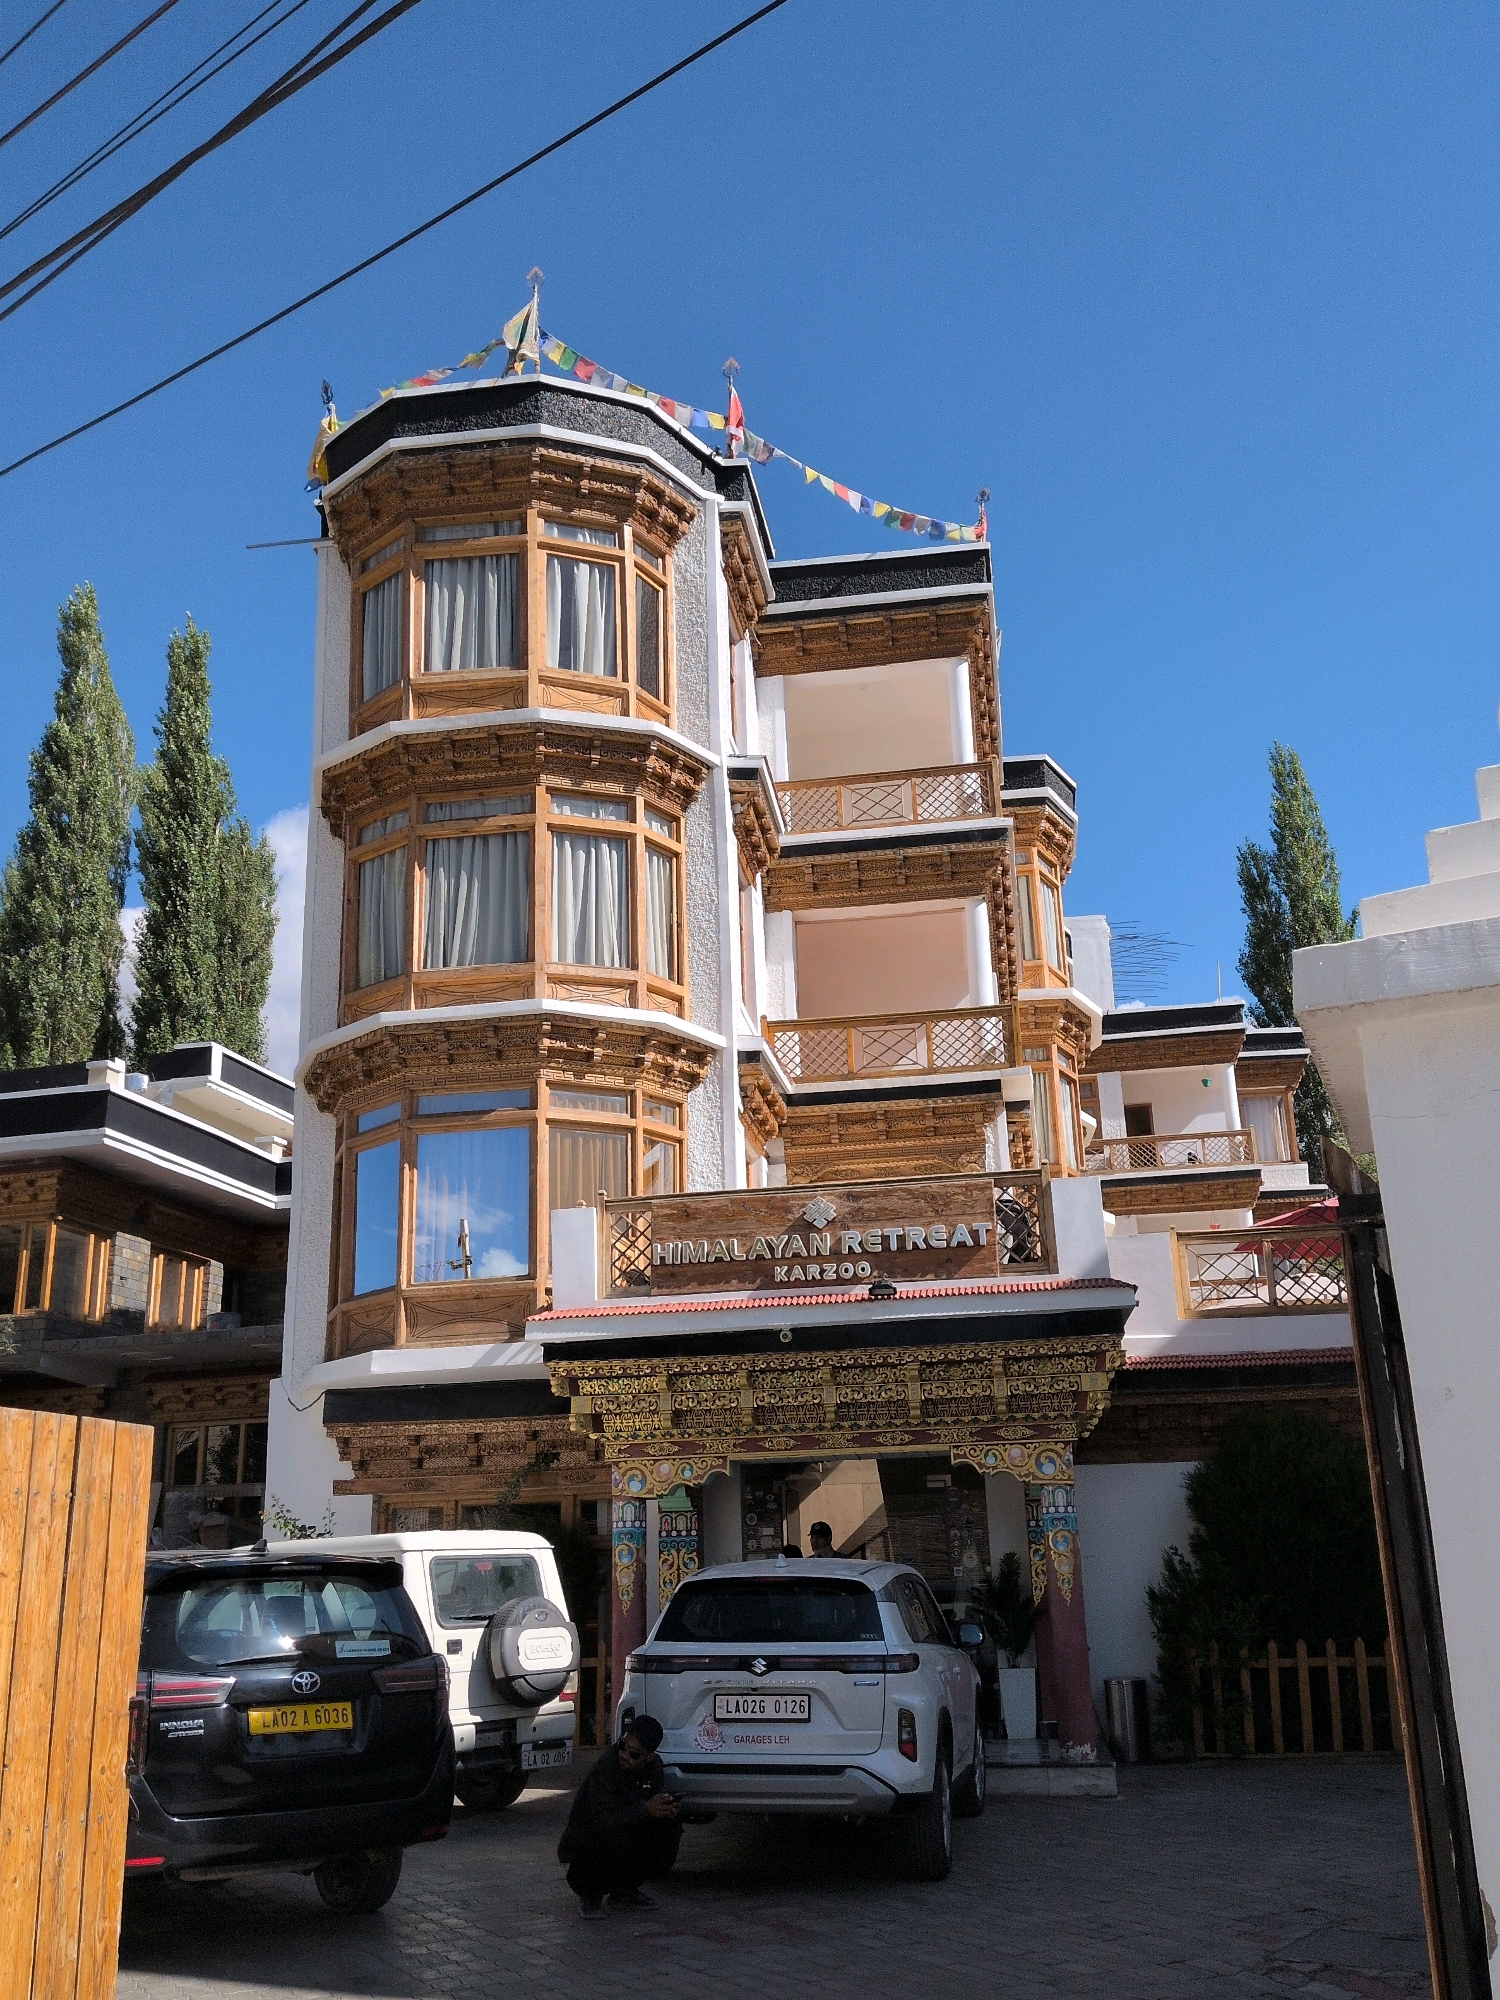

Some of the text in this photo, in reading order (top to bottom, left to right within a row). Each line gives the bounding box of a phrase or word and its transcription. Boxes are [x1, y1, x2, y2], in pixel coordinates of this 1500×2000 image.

[652, 1222, 992, 1265] HIMALAYAN RETREAT
[774, 1261, 871, 1282] KARZOO
[726, 1699, 766, 1714] LA02G
[774, 1699, 806, 1714] 0126
[262, 1707, 349, 1728] LA02 A 6036
[733, 1735, 790, 1744] GARAGES LEH
[527, 1754, 538, 1766] LA
[541, 1753, 550, 1765] 02
